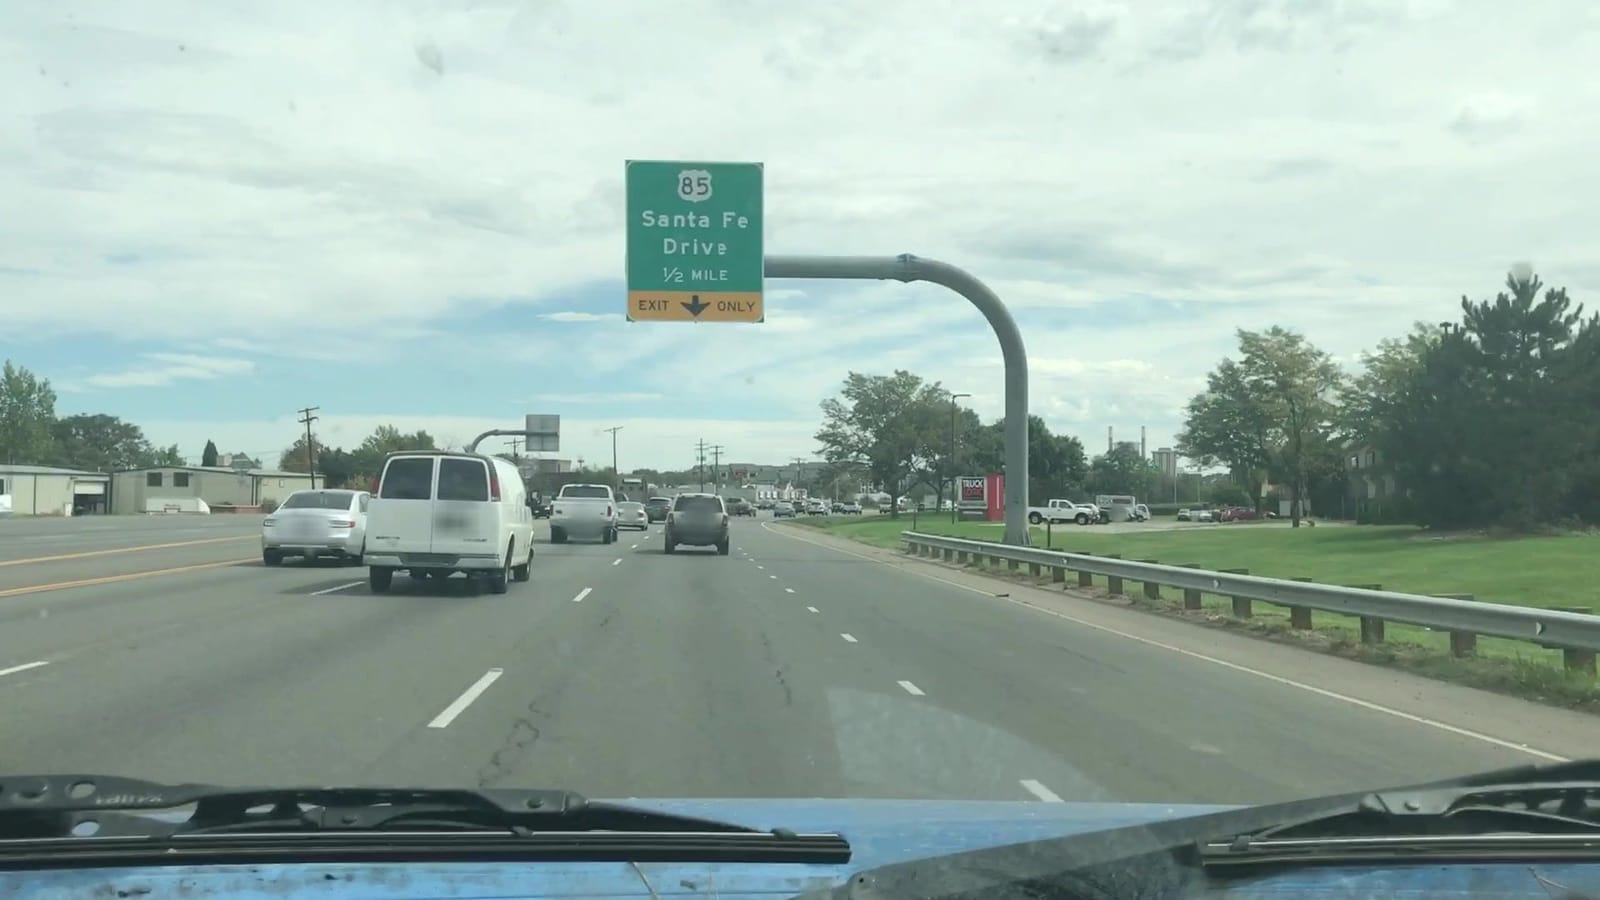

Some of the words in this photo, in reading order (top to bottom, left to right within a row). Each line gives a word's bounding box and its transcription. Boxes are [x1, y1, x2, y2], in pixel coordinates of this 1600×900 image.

[681, 176, 710, 196] 85
[642, 210, 710, 228] Santa
[722, 211, 749, 229] Fe
[663, 238, 728, 255] Drive
[691, 269, 728, 281] MILE
[638, 299, 670, 311] EXIT
[717, 301, 755, 312] ONLY
[963, 479, 983, 488] TRUCK
